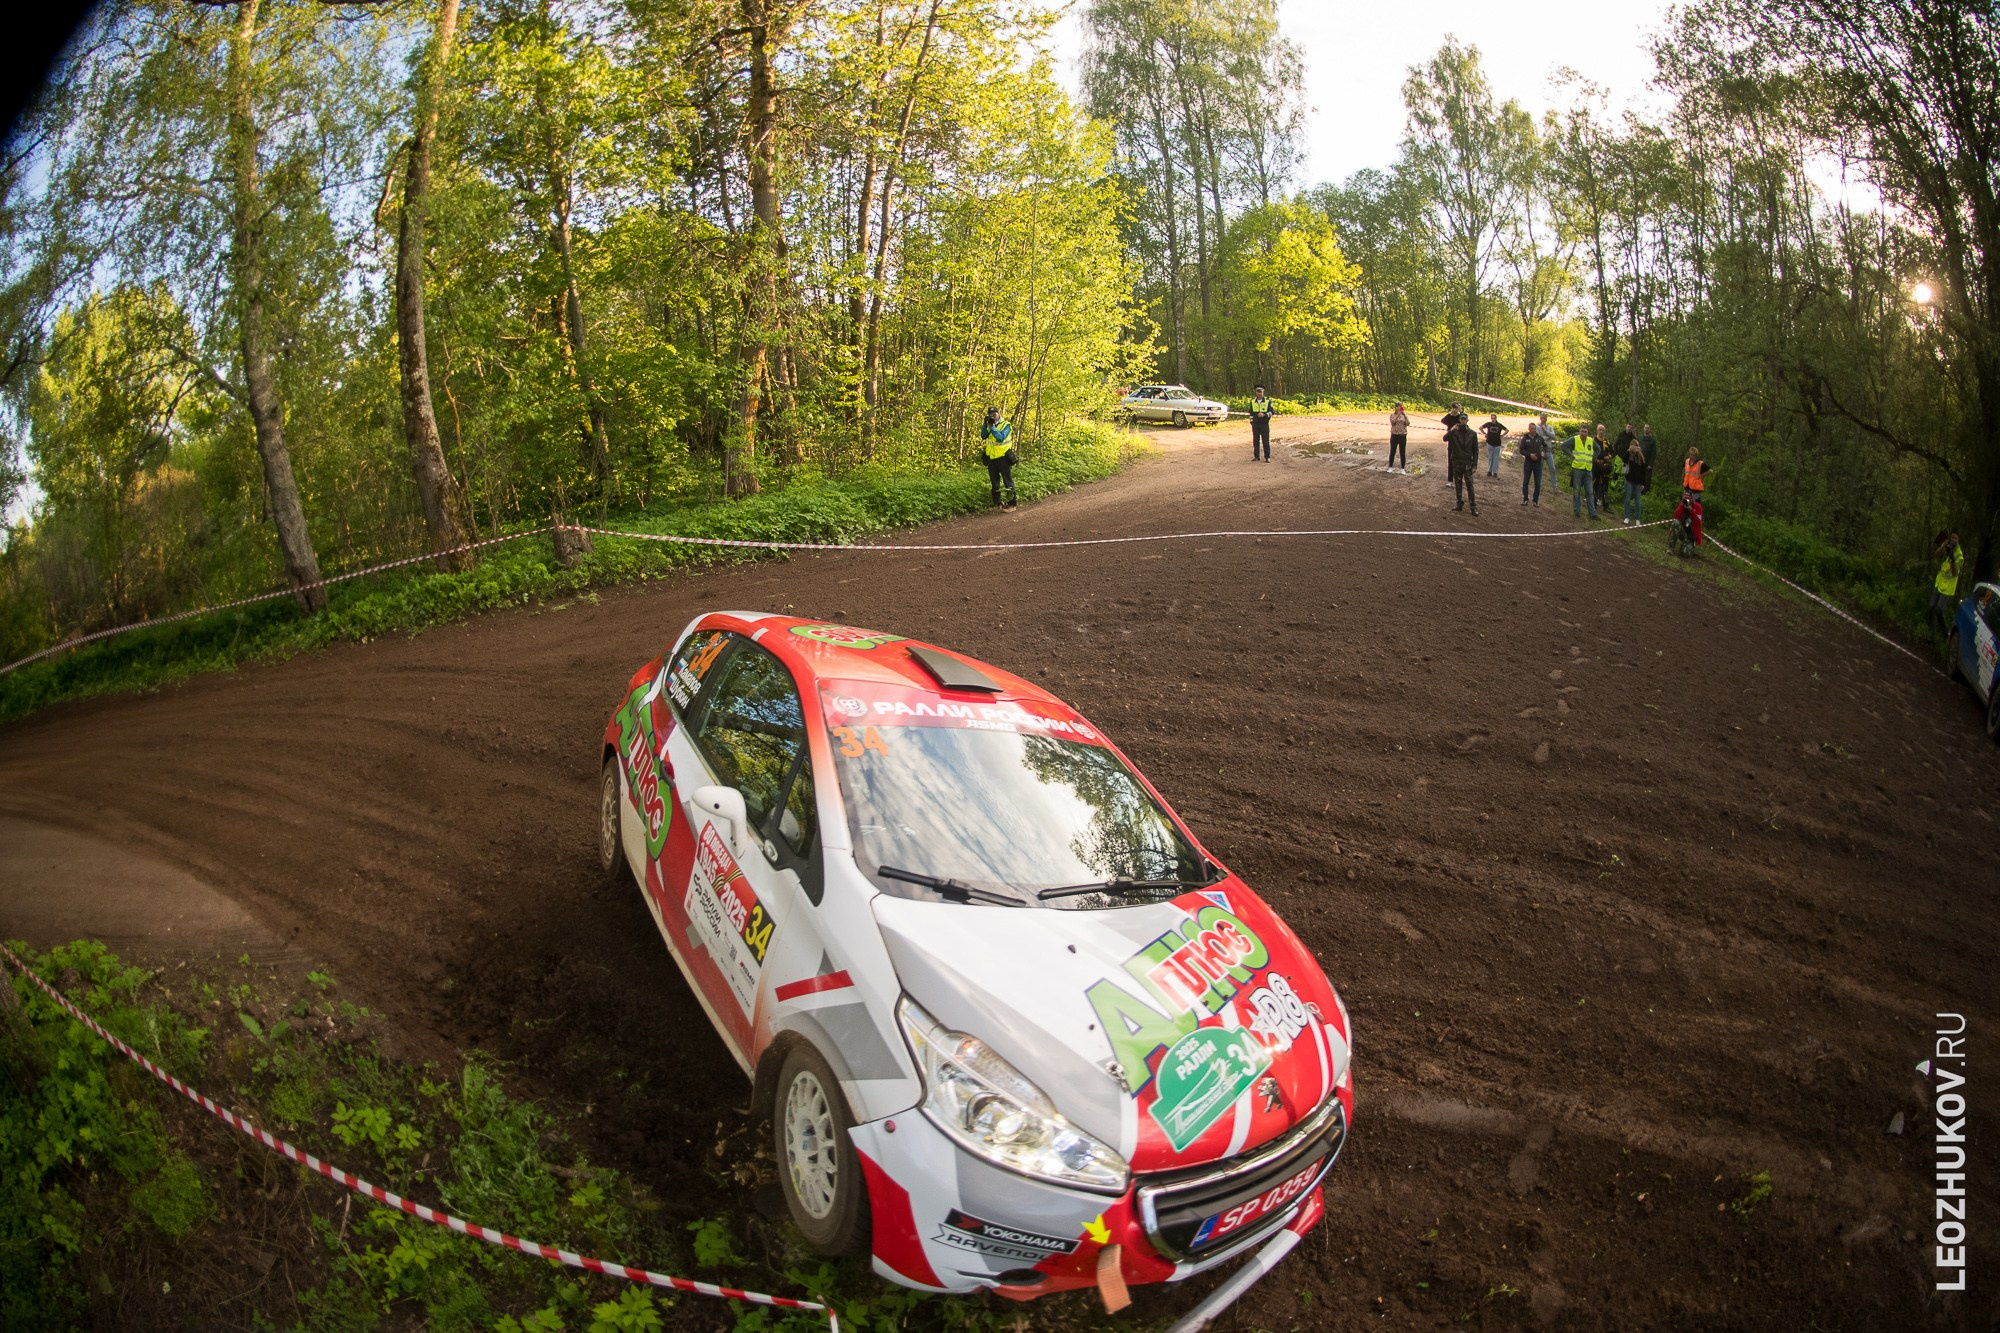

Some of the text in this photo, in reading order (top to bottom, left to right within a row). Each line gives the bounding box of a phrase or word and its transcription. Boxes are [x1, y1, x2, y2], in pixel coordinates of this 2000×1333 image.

[689, 632, 730, 680] 34
[872, 701, 1075, 734] РАЛЛИ РОССИИ
[833, 726, 889, 758] 34
[703, 824, 715, 846] 80
[699, 842, 718, 885] 1945
[720, 882, 748, 933] 2025
[745, 905, 773, 961] 34
[1175, 1036, 1201, 1061] 2025
[1175, 1039, 1218, 1080] РАЛЛИ
[1226, 1031, 1269, 1076] 34
[1218, 1162, 1318, 1233] SP 0359
[983, 1224, 1066, 1250] YOKOHAMA
